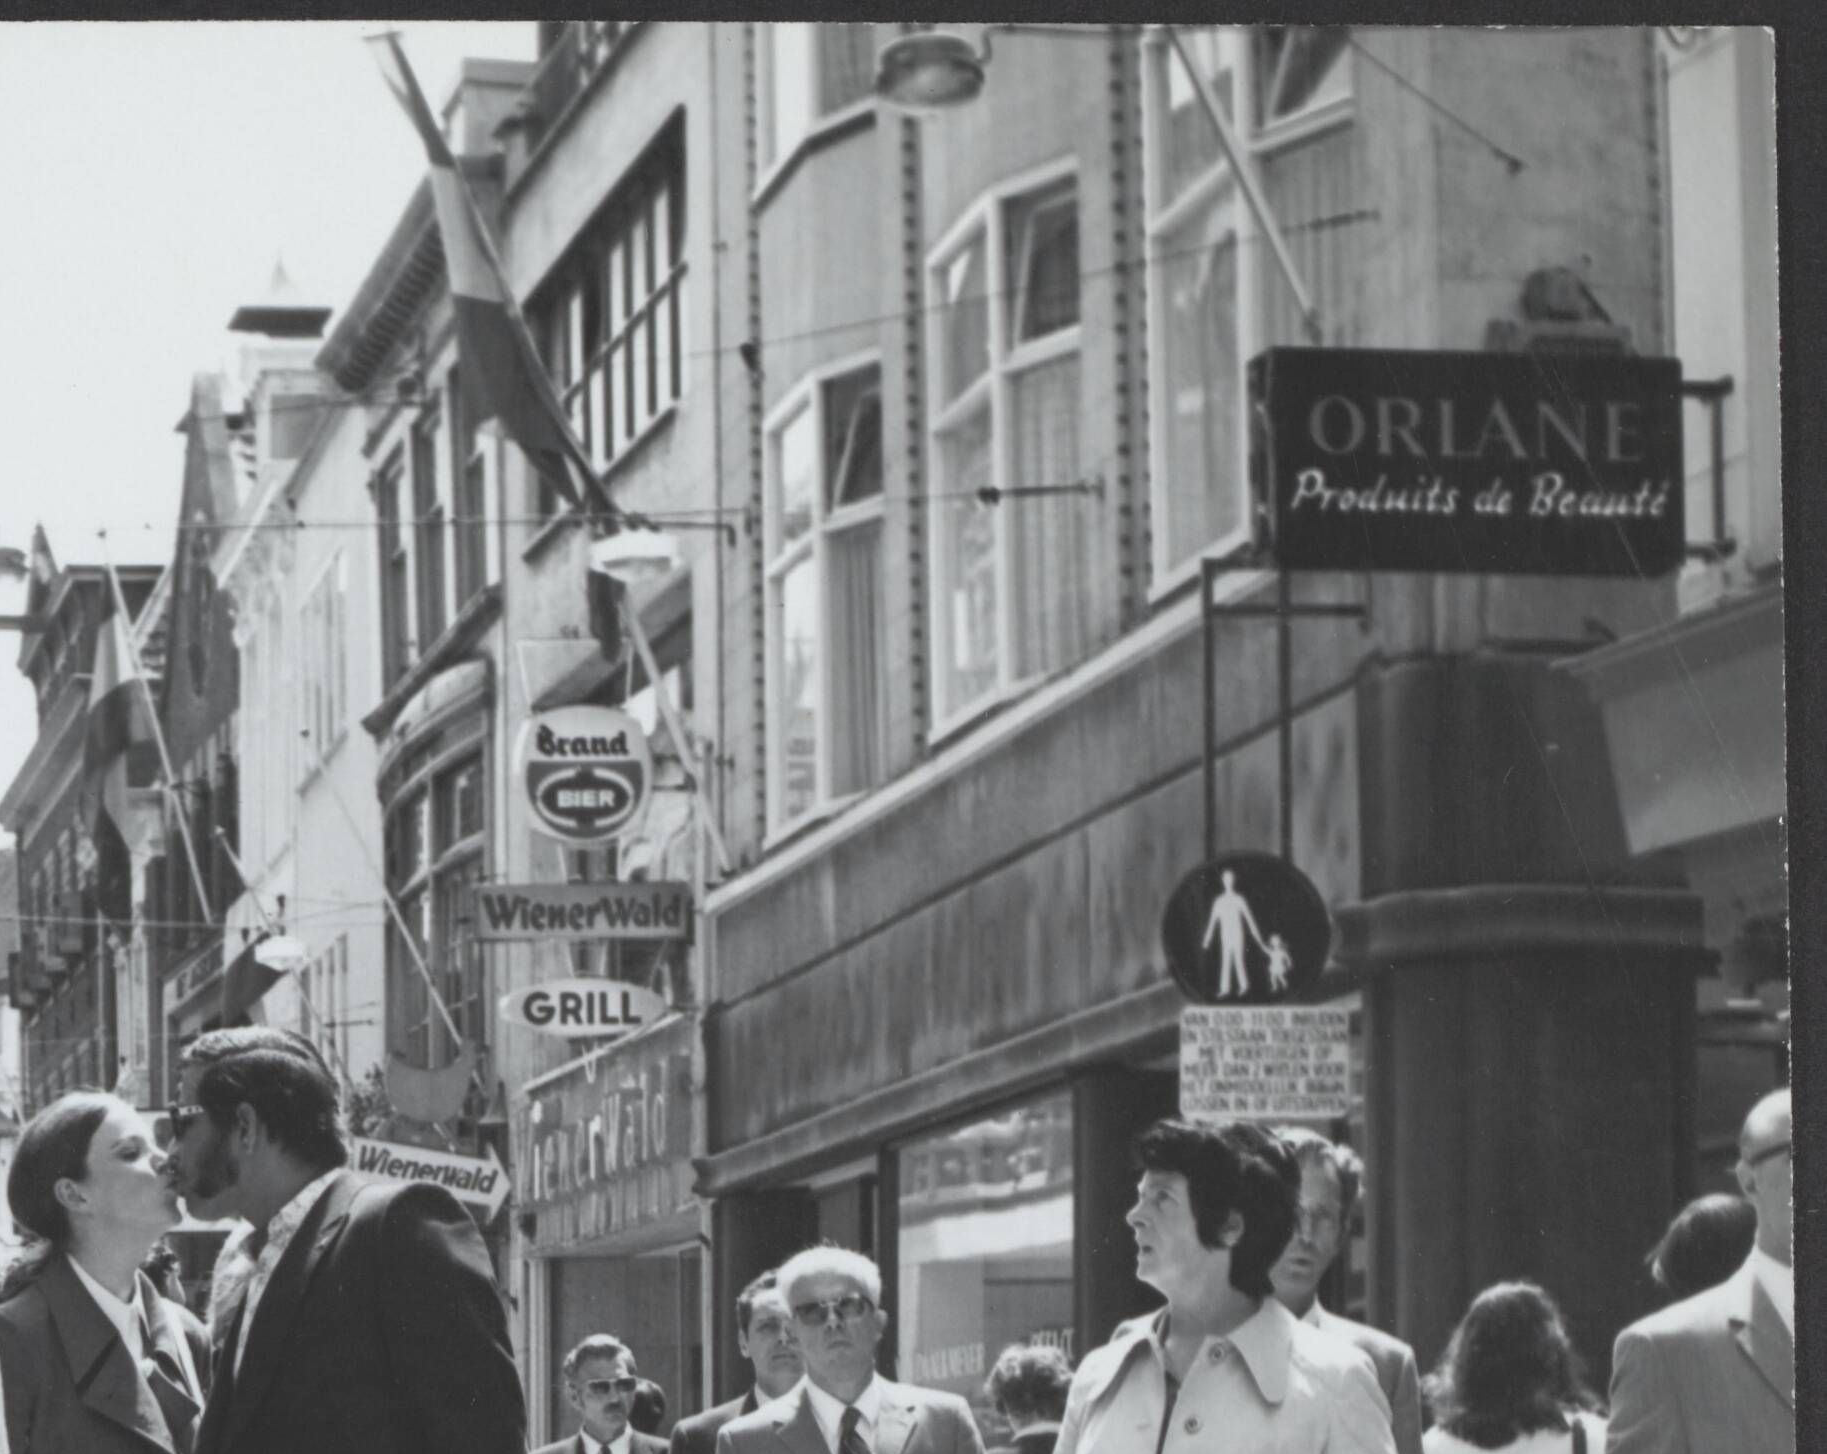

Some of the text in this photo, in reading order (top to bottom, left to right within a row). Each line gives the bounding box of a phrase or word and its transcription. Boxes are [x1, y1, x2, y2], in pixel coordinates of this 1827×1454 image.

[1309, 394, 1645, 462] ORLANE
[1291, 467, 1671, 517] Produits de Beauté
[536, 723, 630, 757] Brand
[557, 789, 615, 809] BIER
[523, 991, 642, 1026] GRILL
